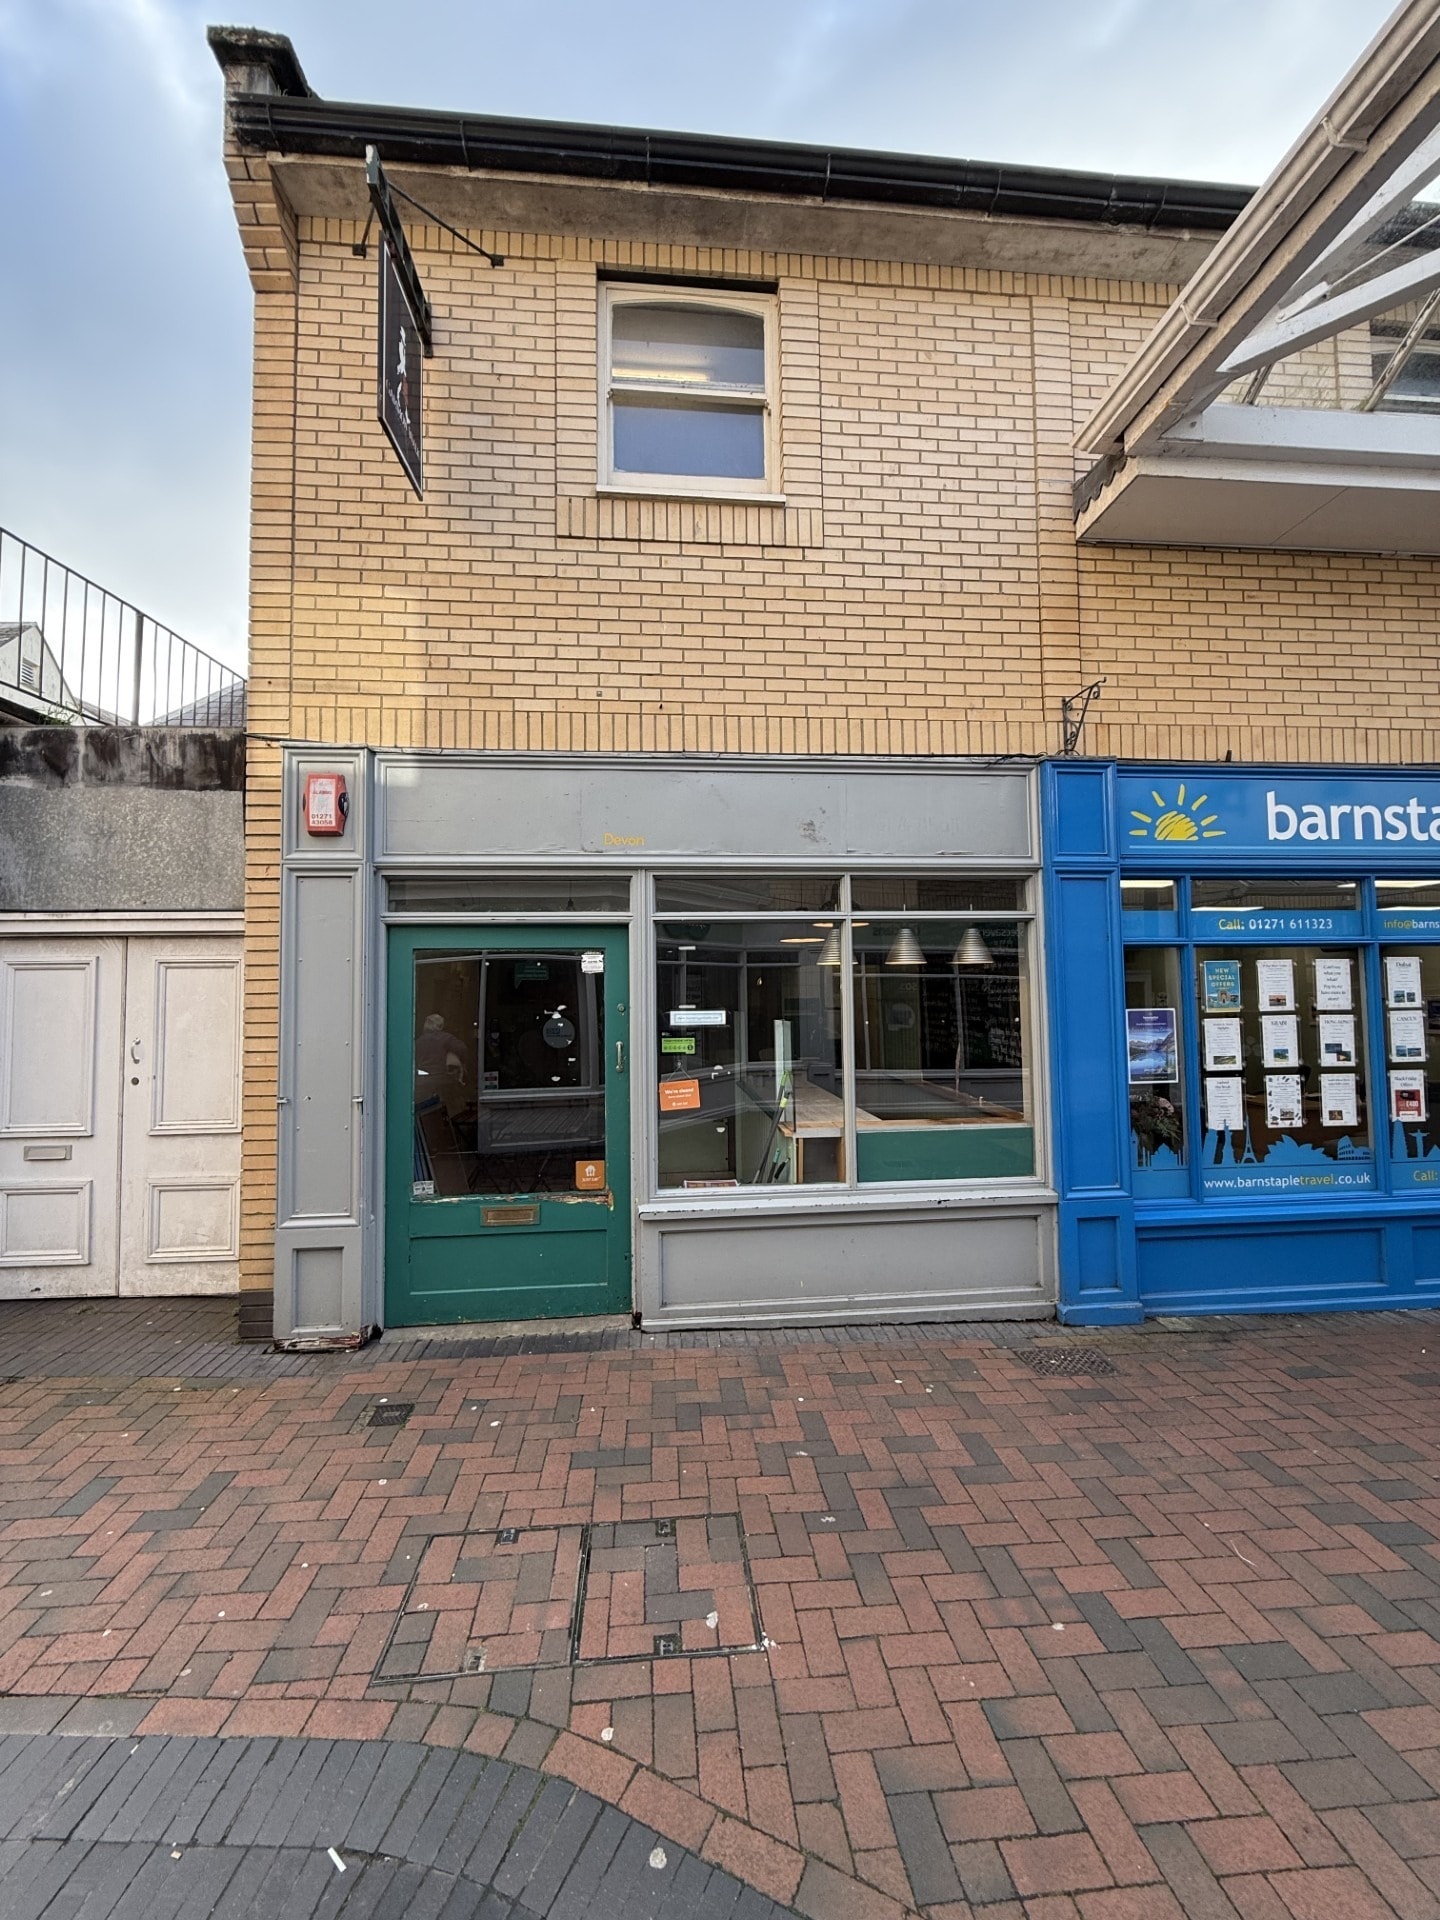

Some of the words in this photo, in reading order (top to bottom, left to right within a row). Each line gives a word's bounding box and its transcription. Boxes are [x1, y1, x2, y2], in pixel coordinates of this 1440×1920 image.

[603, 832, 645, 846] Devon
[1218, 918, 1245, 930] Call:
[1248, 918, 1284, 930] 01271
[1289, 918, 1333, 930] 611323
[1203, 1172, 1371, 1192] www.barnstapletravel.co.uk
[1413, 1170, 1438, 1182] Call:
